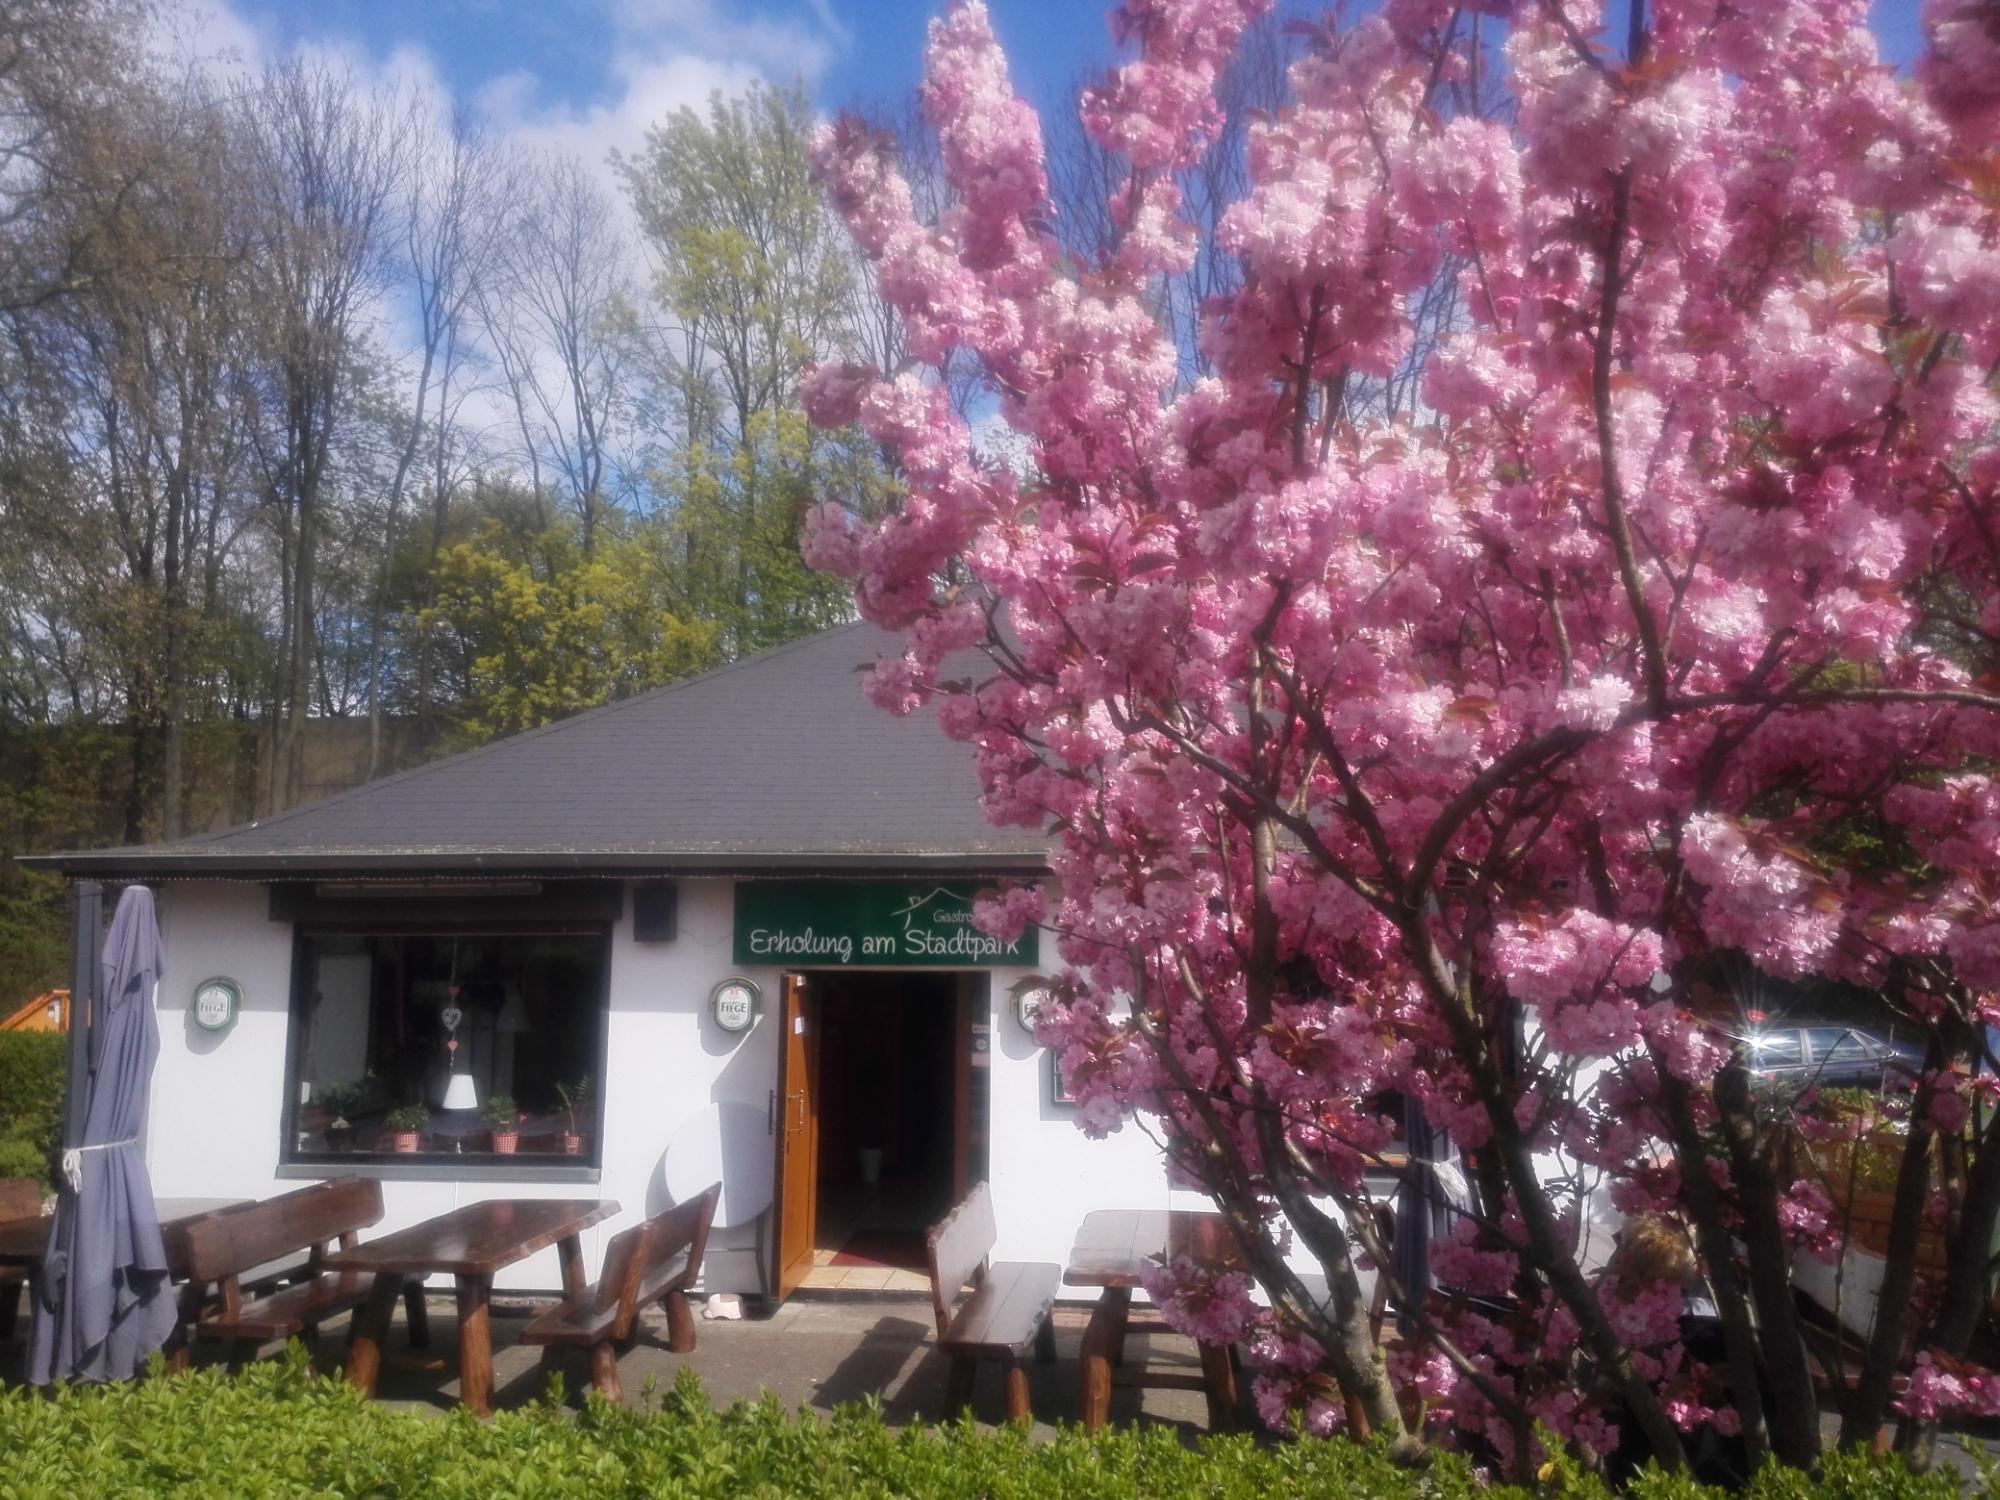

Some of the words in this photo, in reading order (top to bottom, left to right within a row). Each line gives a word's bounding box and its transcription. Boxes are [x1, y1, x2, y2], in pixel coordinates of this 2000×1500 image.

[933, 909, 975, 923] Gastro
[750, 927, 853, 963] Erholung
[862, 936, 896, 955] am
[720, 1001, 748, 1013] FIEGE
